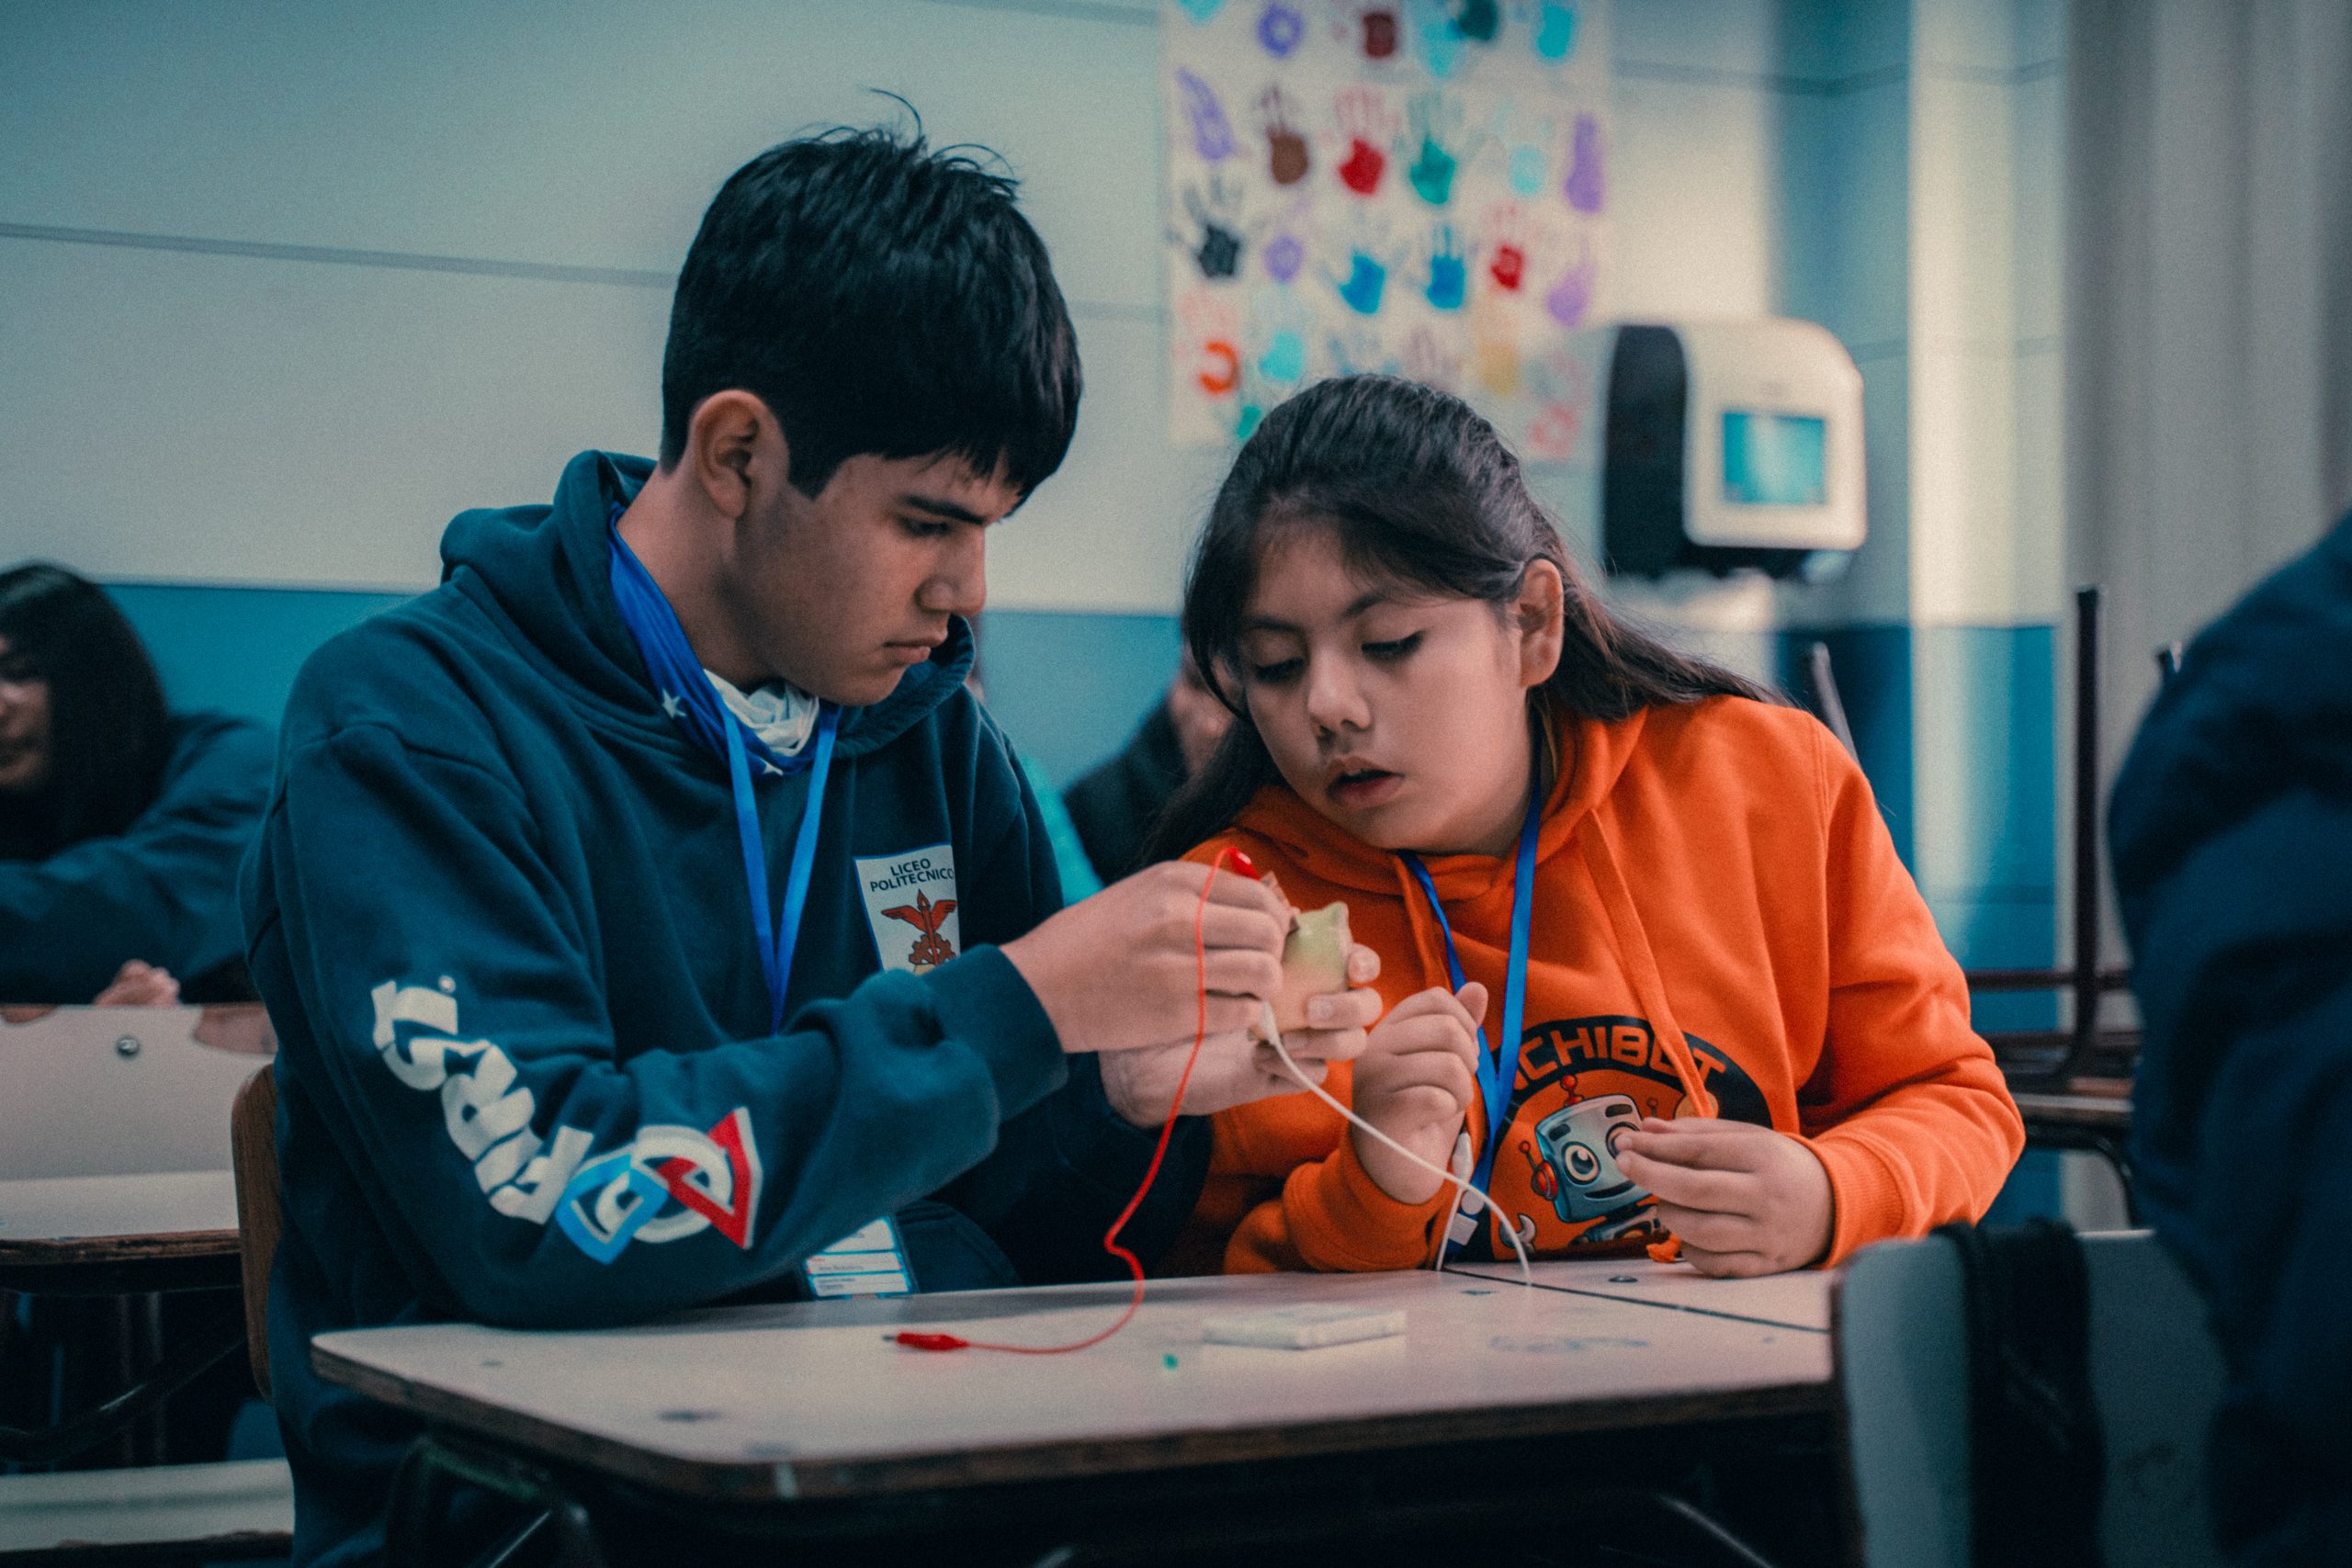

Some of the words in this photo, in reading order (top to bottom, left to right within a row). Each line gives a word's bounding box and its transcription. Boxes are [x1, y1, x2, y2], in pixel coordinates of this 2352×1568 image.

[869, 867, 955, 893] POLITECNICO
[889, 858, 932, 877] LICEO
[370, 980, 594, 1225] FIRST
